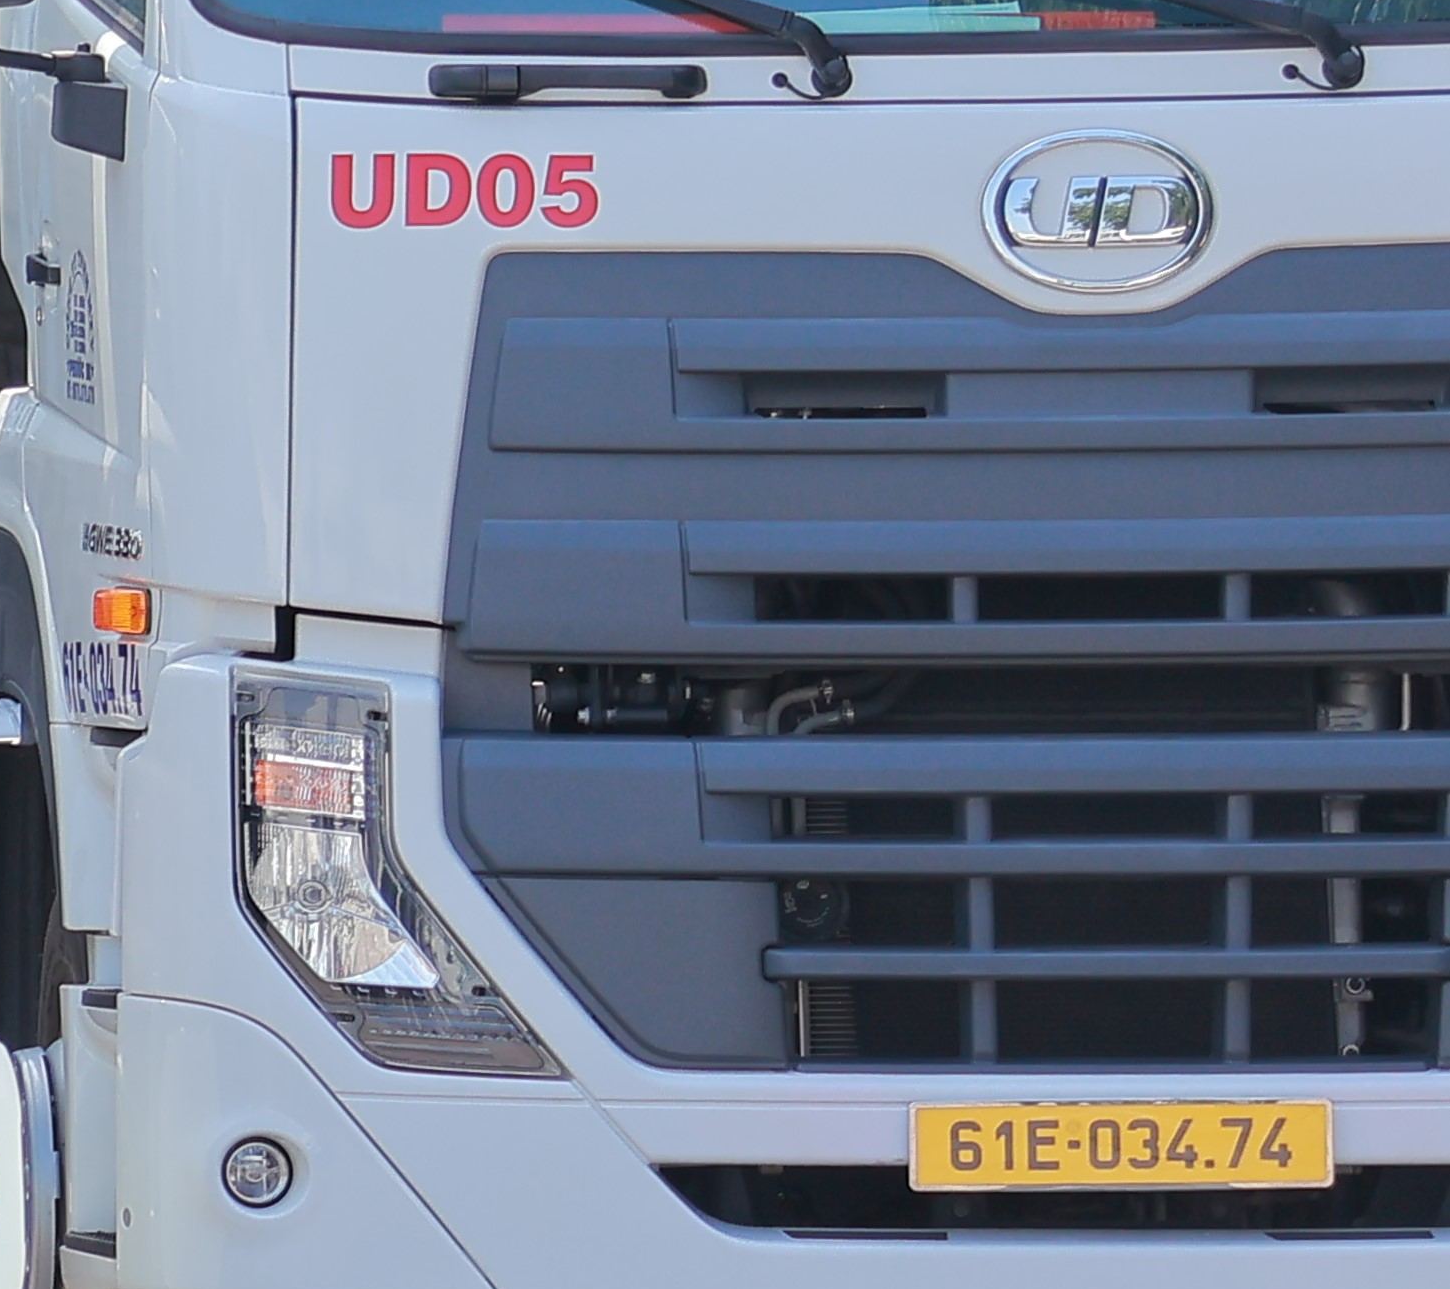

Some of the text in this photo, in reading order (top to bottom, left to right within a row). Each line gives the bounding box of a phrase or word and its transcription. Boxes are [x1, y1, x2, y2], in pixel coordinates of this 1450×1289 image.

[330, 153, 599, 229] UD05
[1002, 175, 1200, 248] UD
[949, 1116, 1293, 1173] 61E-034.74
